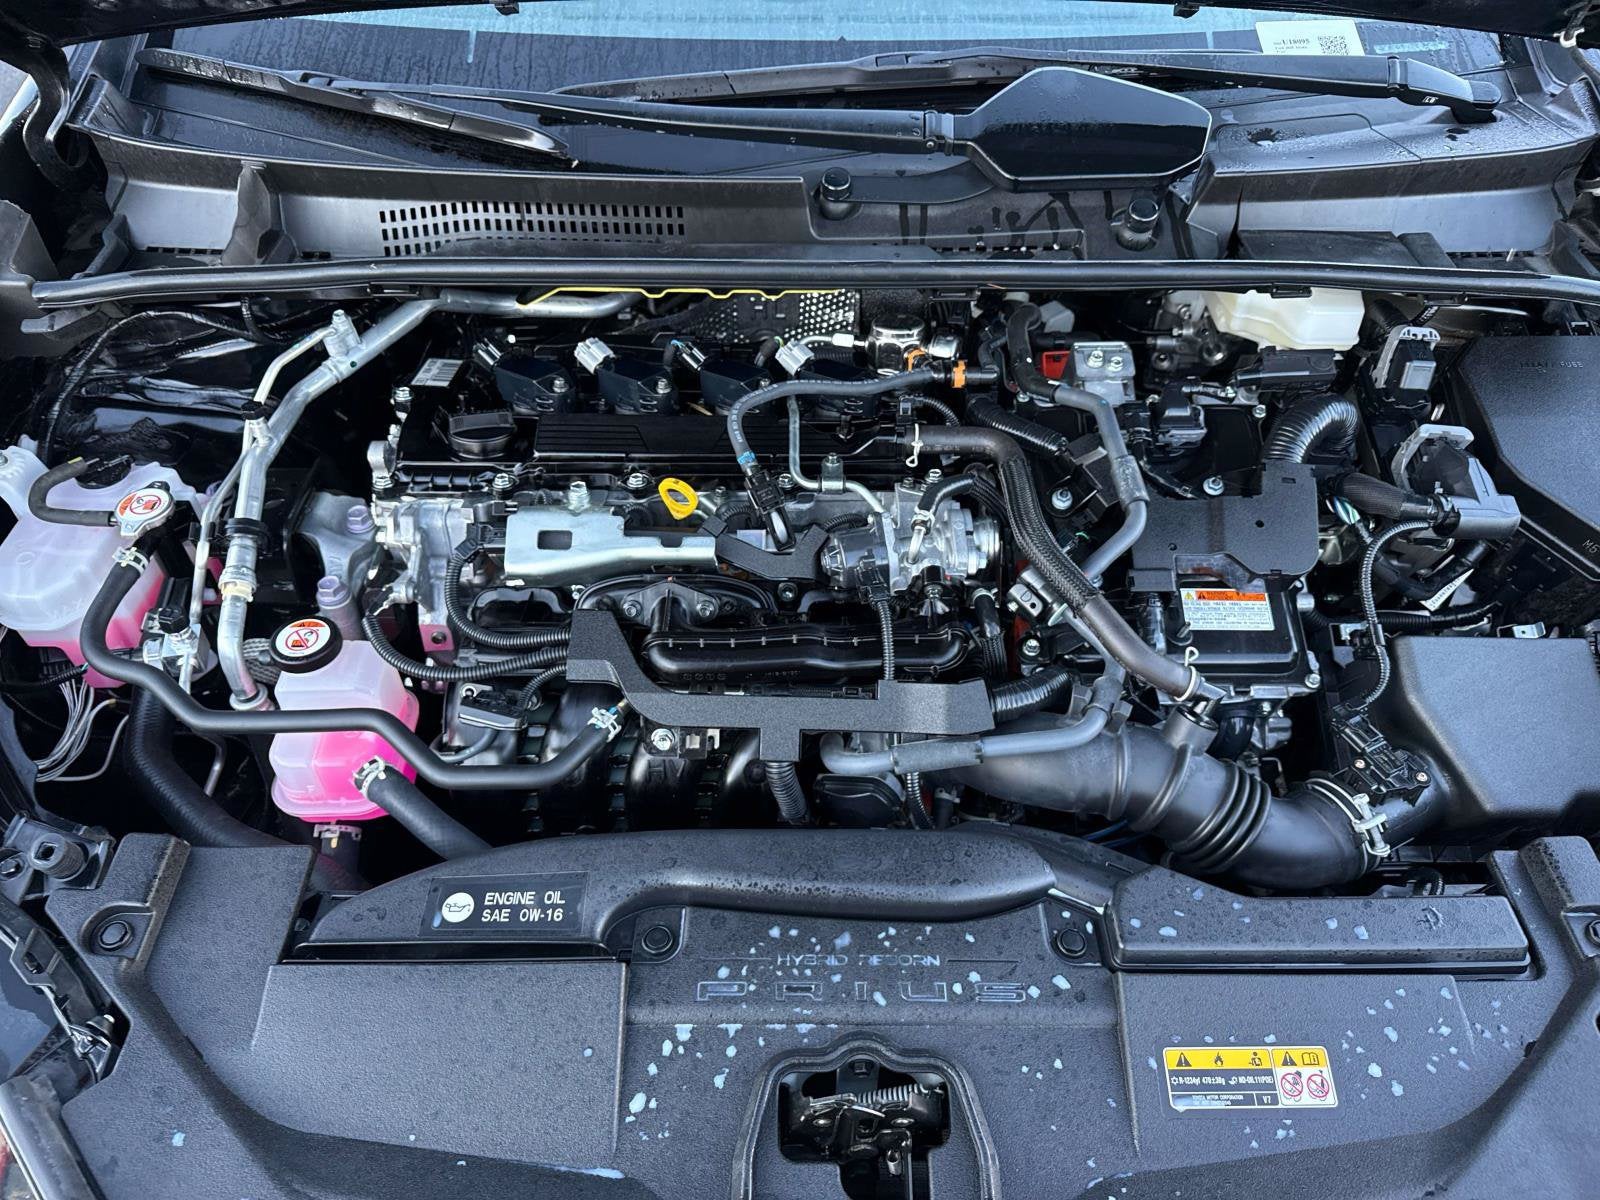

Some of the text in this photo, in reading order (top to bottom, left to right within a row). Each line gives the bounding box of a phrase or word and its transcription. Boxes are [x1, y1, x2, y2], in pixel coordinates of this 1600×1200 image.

[484, 890, 566, 905] ENGINE OIL
[481, 908, 563, 922] SAE 0W-16
[777, 954, 941, 966] HYBRID REBORN
[697, 981, 1026, 1002] PRIUS
